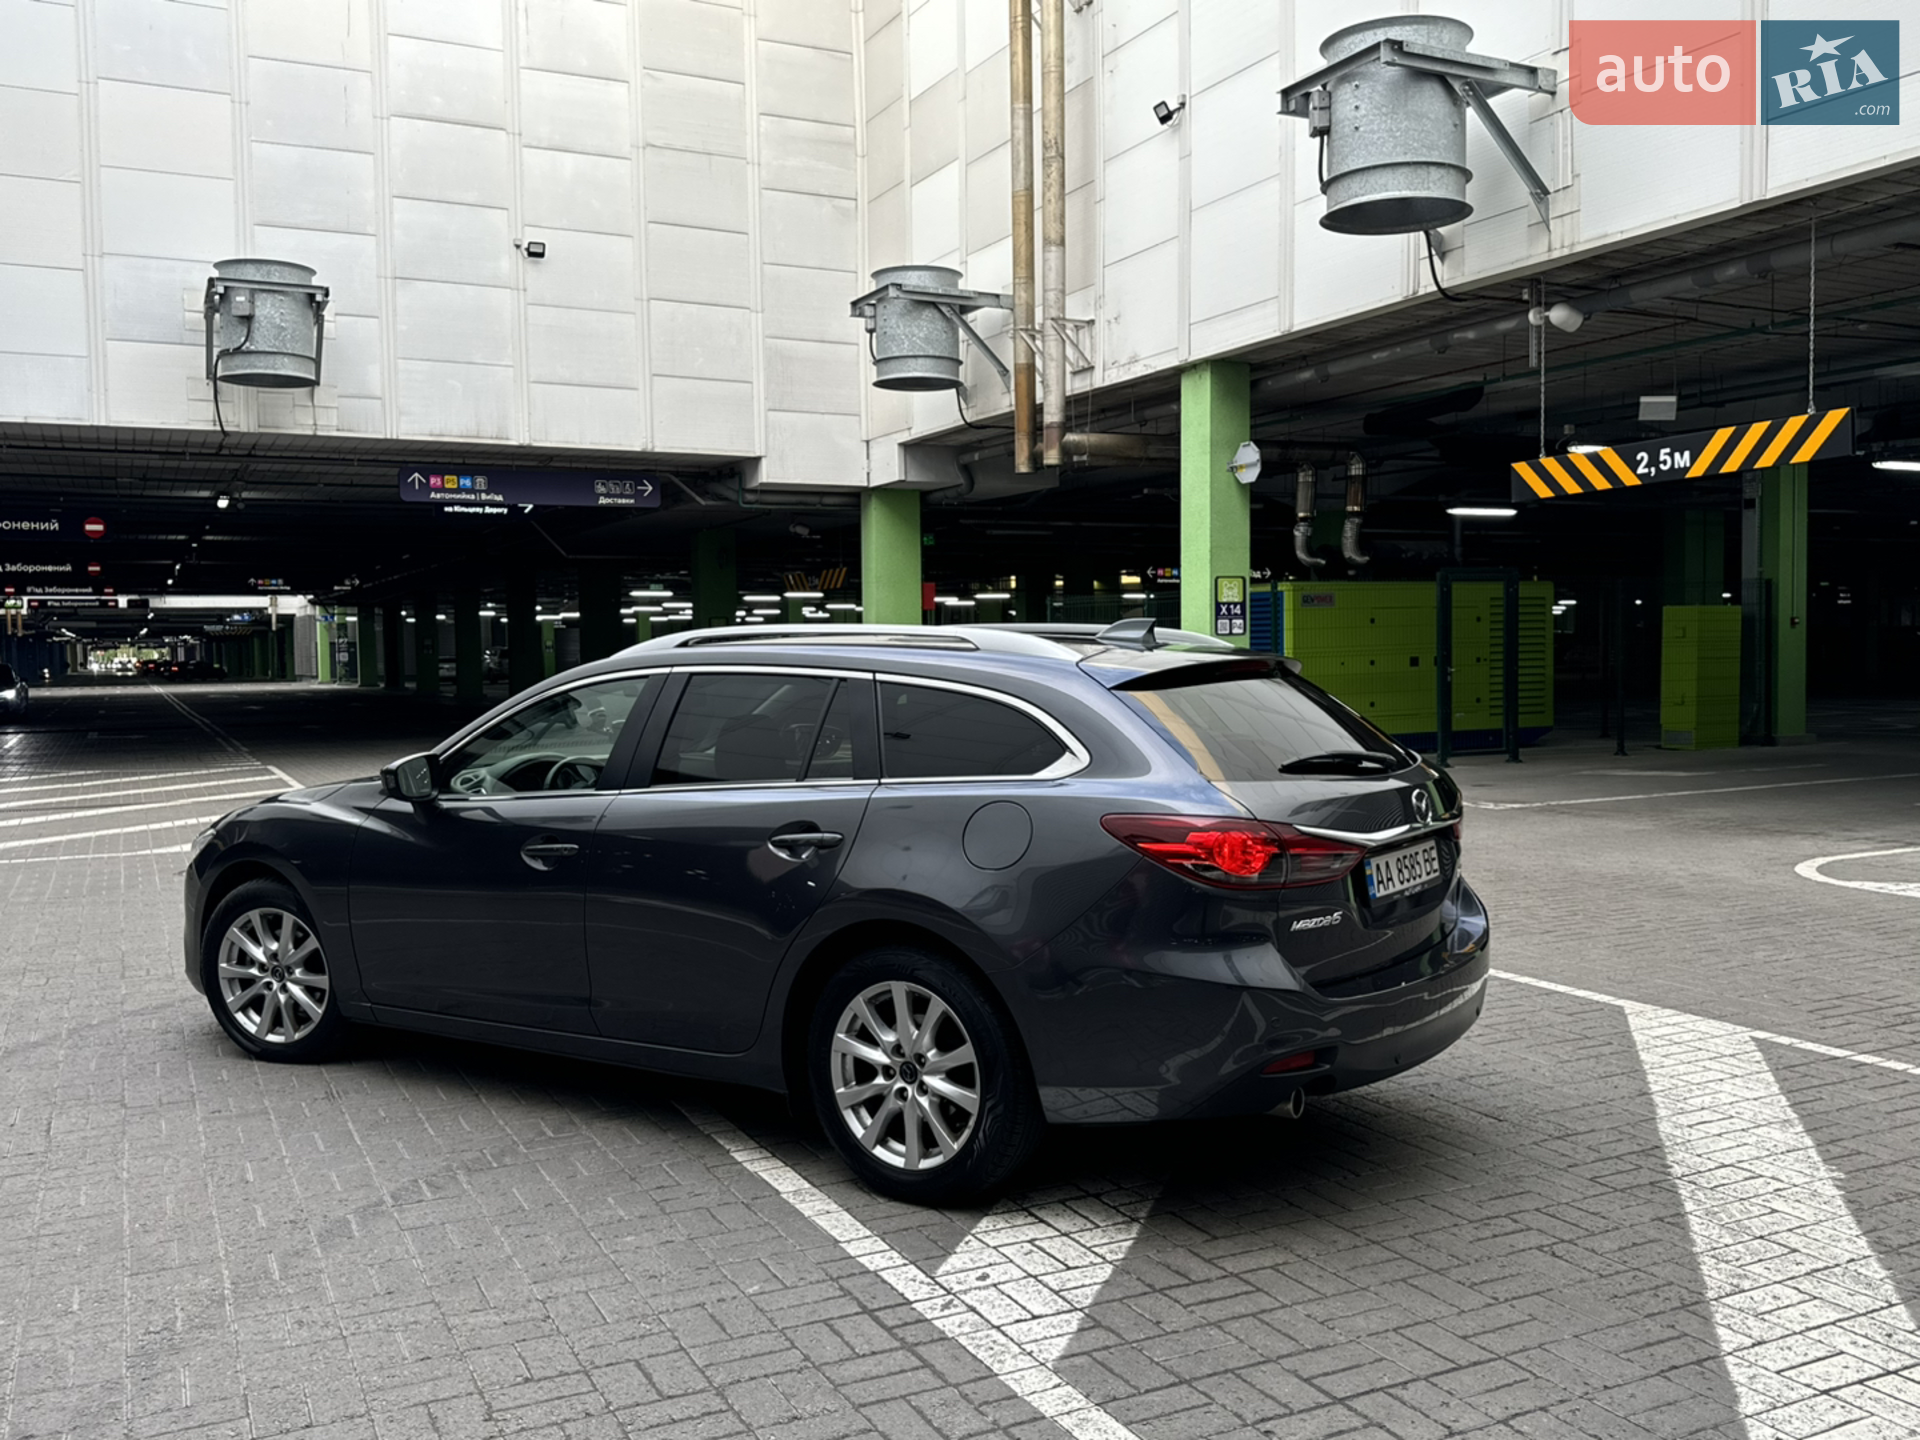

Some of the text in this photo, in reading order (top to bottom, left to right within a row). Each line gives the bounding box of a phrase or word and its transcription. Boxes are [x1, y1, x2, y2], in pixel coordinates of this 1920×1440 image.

[430, 492, 475, 500] Автомийка
[598, 496, 635, 505] Доставки
[4, 562, 72, 574] Заборонений
[1229, 604, 1242, 616] 14
[1377, 845, 1438, 893] AA 8585 BE
